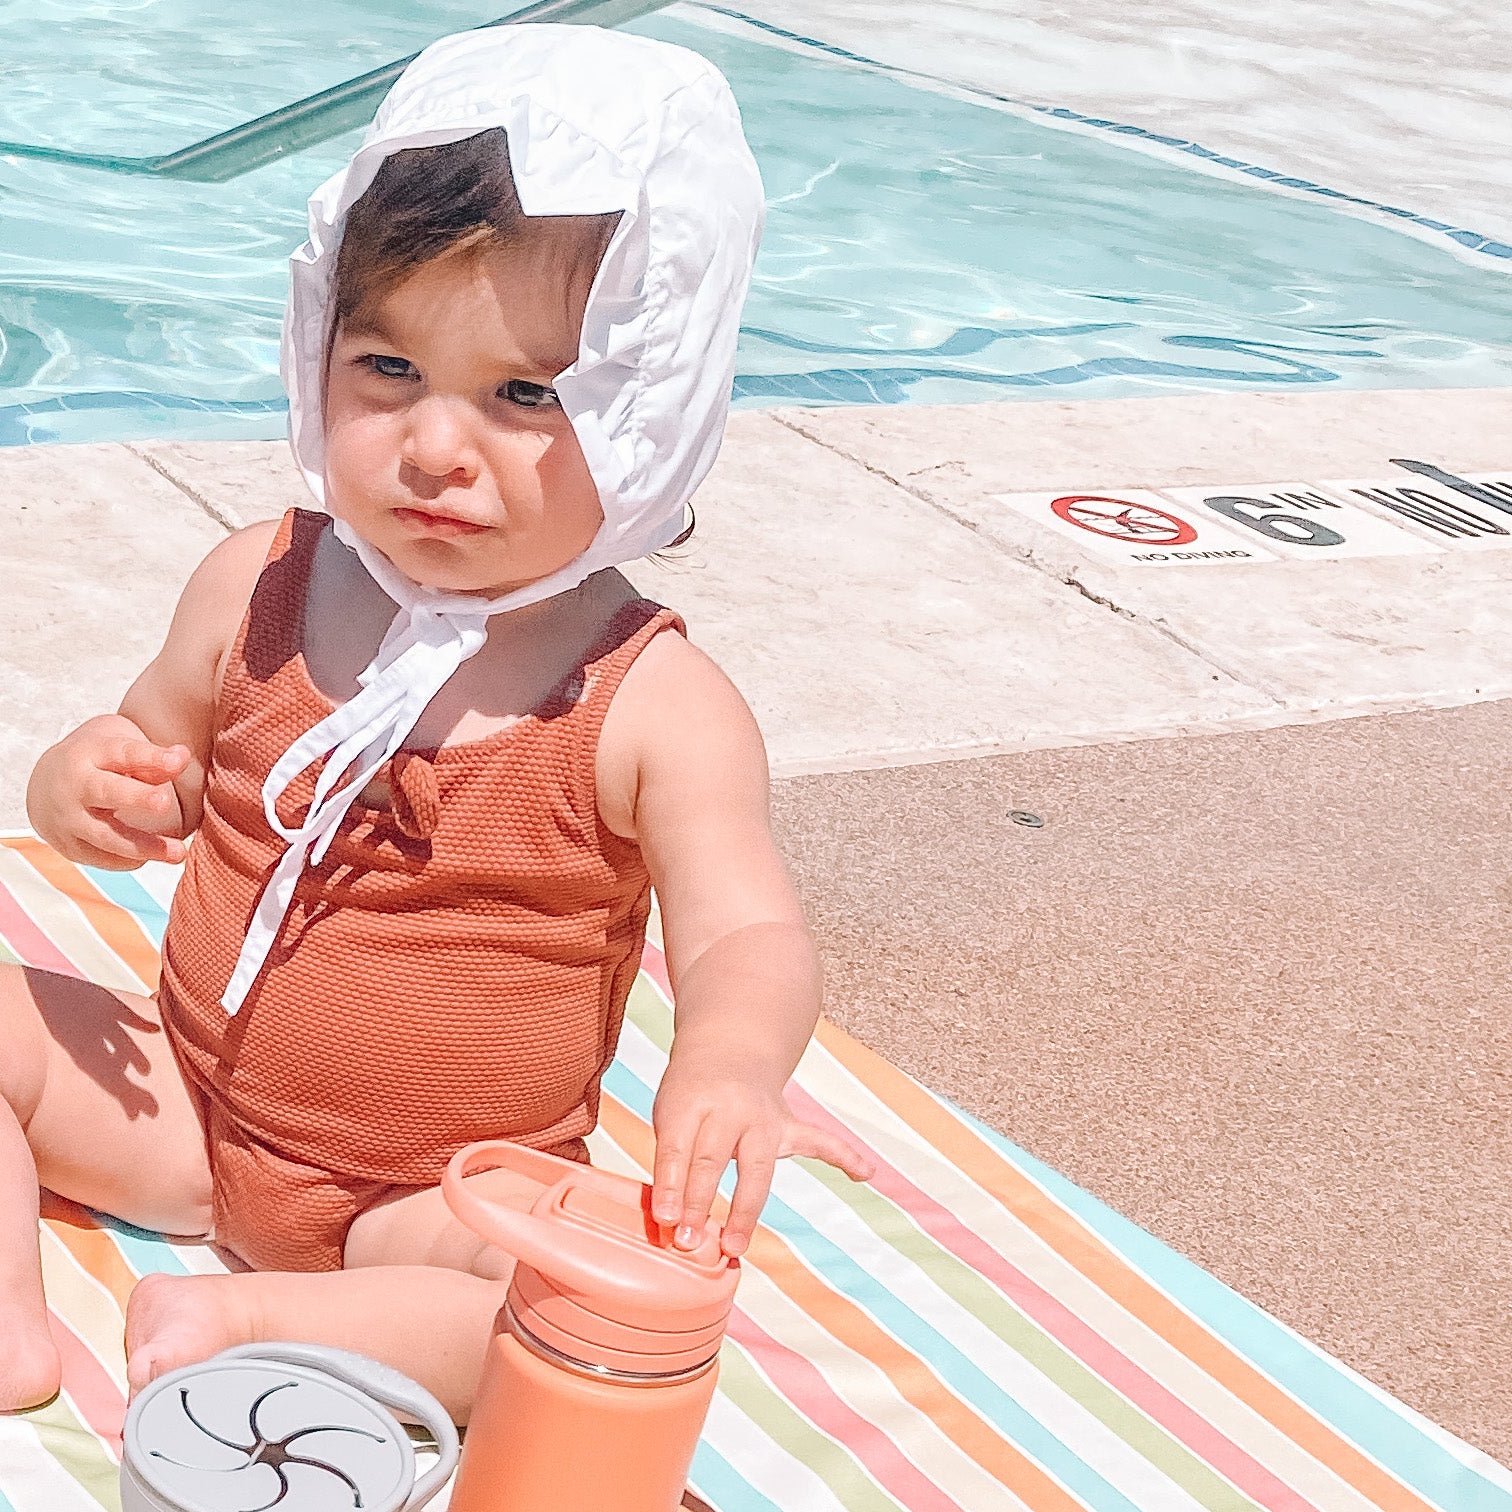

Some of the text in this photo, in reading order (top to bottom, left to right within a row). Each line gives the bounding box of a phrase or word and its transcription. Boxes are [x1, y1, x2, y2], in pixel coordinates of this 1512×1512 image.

[1348, 487, 1511, 538] NO
[1130, 550, 1253, 562] NO DIVING
